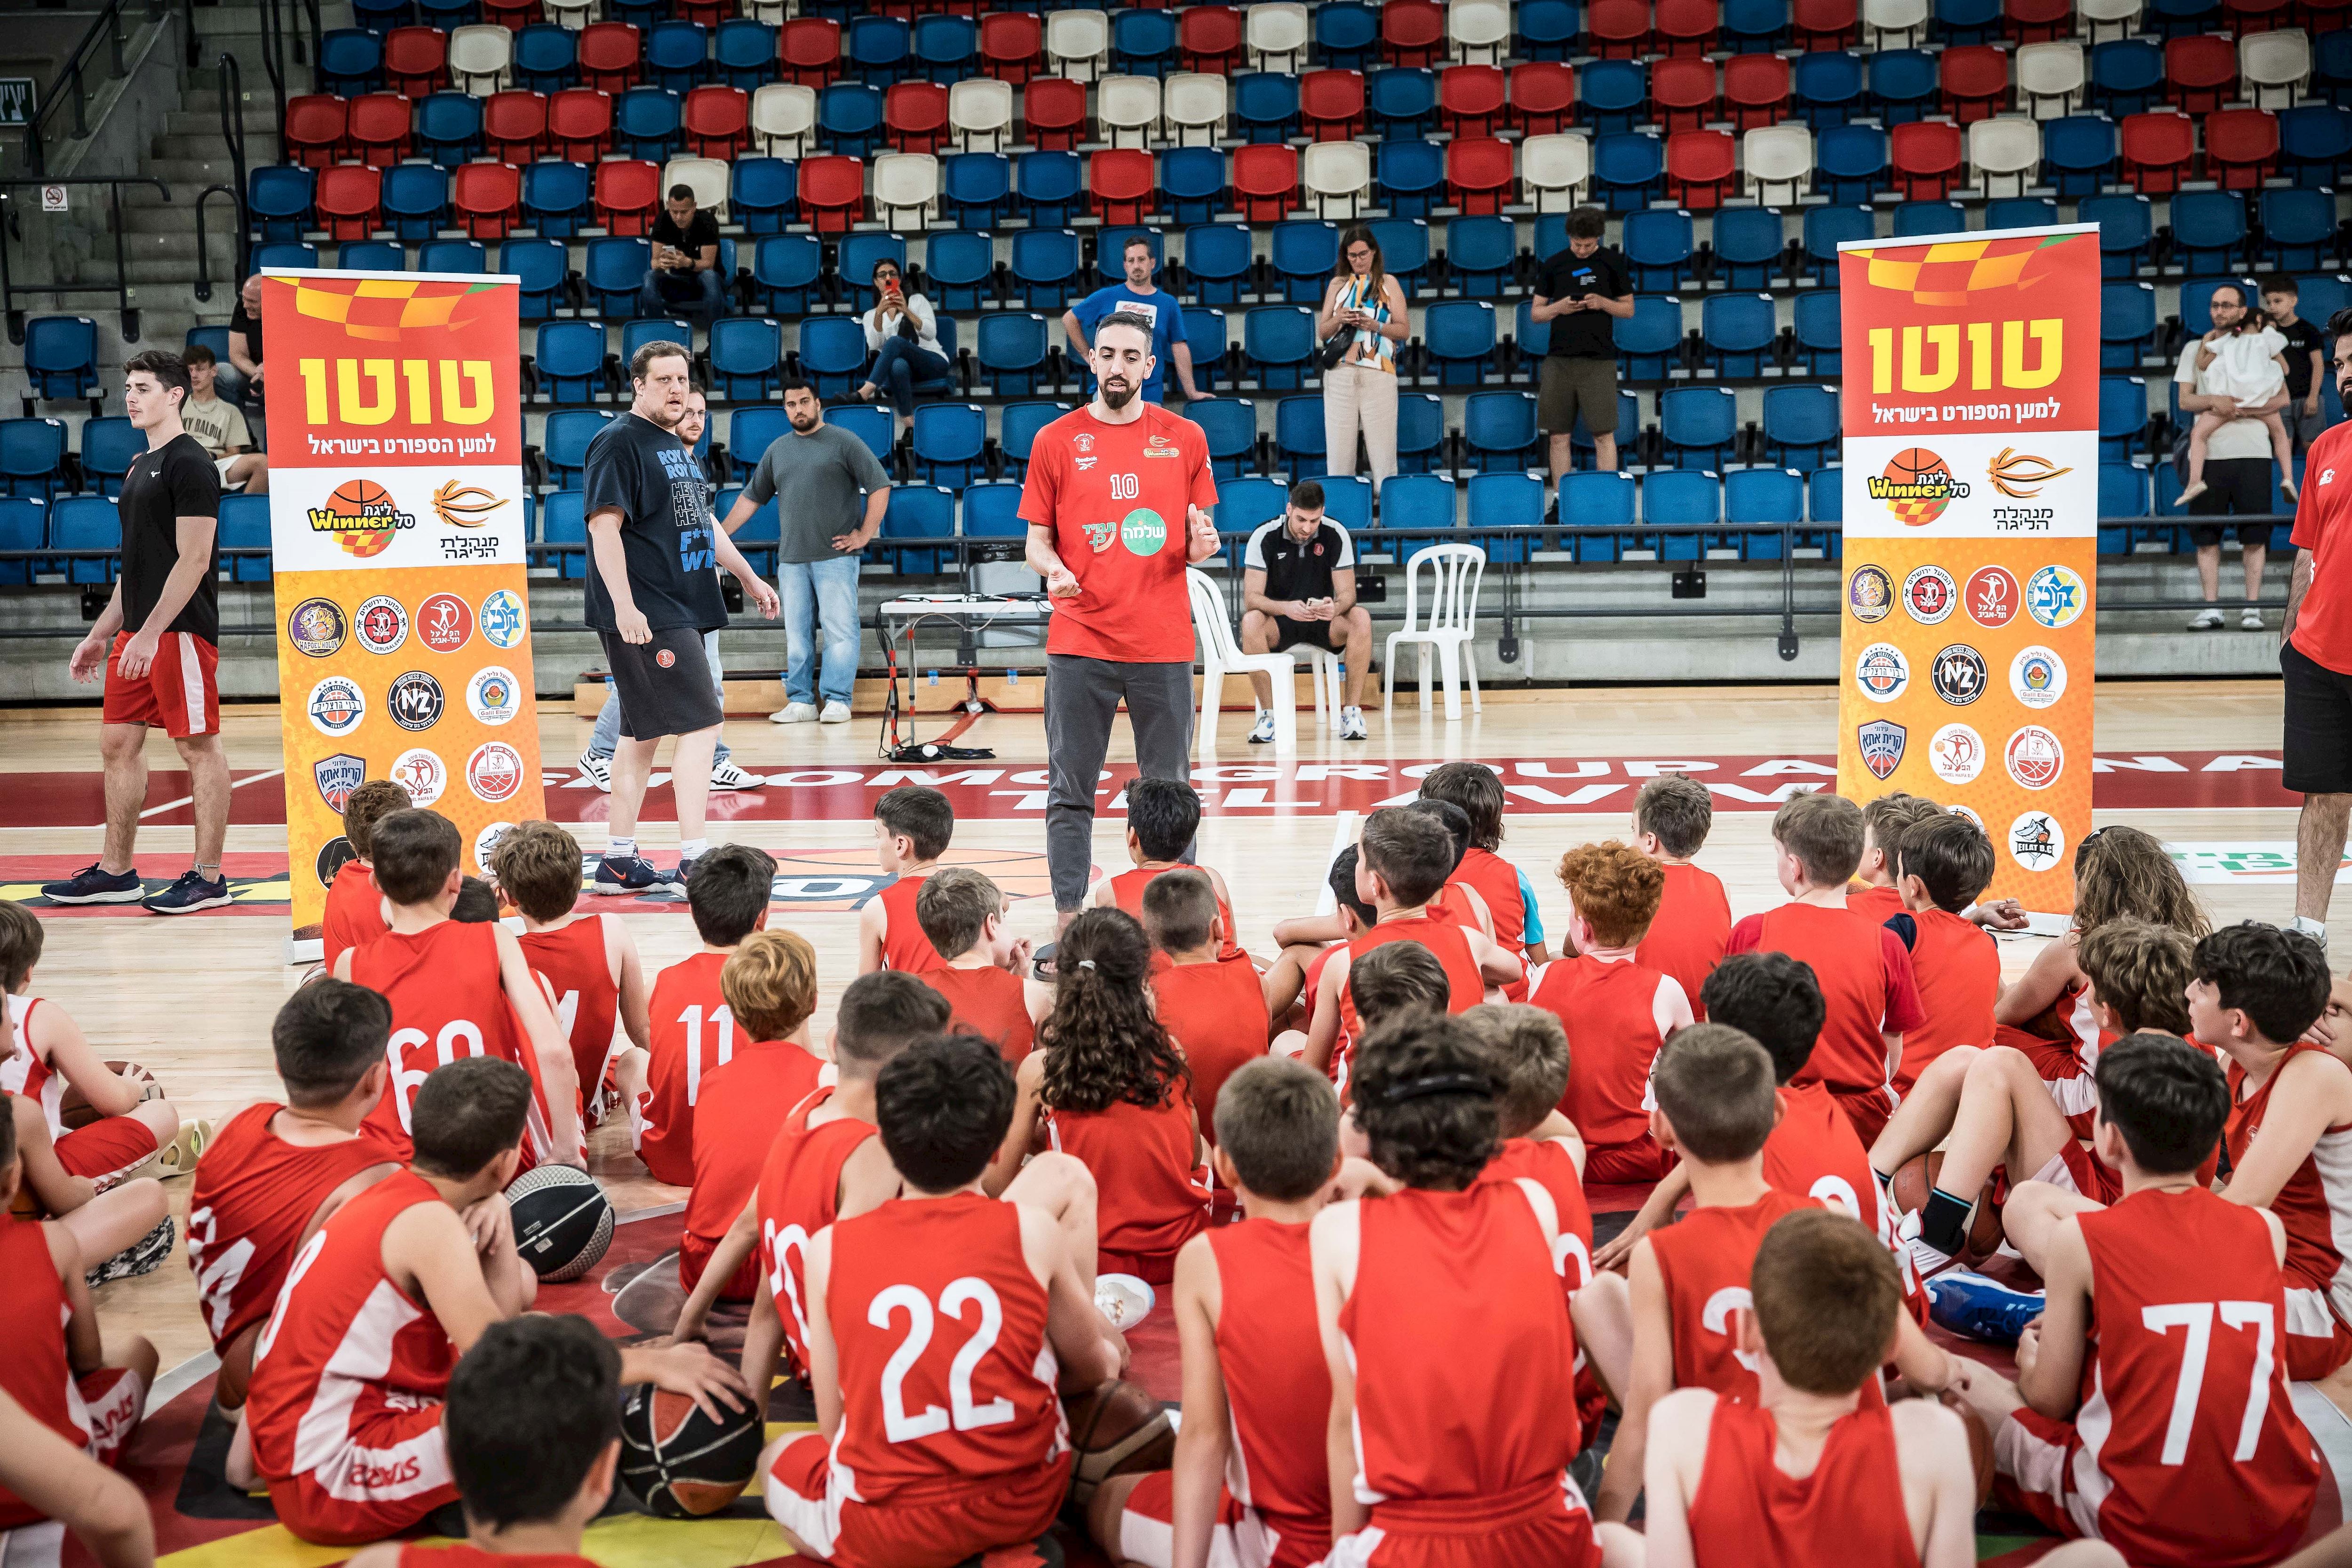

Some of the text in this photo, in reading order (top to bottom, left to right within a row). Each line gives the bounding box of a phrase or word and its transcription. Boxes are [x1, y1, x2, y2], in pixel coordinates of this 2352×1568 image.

[1868, 318, 2063, 394] טוטו
[299, 358, 494, 426] טוטו
[1872, 397, 2061, 424] למען הספורט בישראל
[308, 433, 496, 457] למען הספורט בישראל
[657, 449, 683, 465] ROY
[665, 463, 689, 479] ROY
[1917, 471, 1947, 486] ליגת
[672, 482, 694, 497] HE'S
[1110, 473, 1139, 500] 10
[1869, 478, 1969, 498] Winner סל
[364, 502, 391, 517] ליגת
[673, 495, 699, 512] HE'S
[308, 509, 414, 530] Winner סל
[675, 509, 704, 526] HE'S
[1993, 505, 2054, 519] מנהלת
[1082, 522, 1116, 534] תמיד
[1996, 517, 2049, 530] הליגה
[1123, 525, 1164, 540] שלמה
[440, 537, 499, 549] מנהלת
[445, 546, 496, 559] הליגה
[1908, 568, 1952, 585] הפועל ירושלים
[360, 598, 403, 616] הפועל ירושלים
[1906, 600, 1920, 619] HAPOEL
[1921, 610, 1948, 621] JERUSALEM
[1977, 610, 2007, 619] תל-אביב
[300, 640, 338, 650] HAPOEL HOLON
[359, 632, 373, 649] HAPOEL
[374, 638, 401, 651] JERUSALEM
[430, 636, 460, 645] תל-אביב
[2019, 654, 2030, 666] עליון
[2044, 652, 2057, 668] הפועל
[476, 675, 486, 686] עליון
[500, 672, 512, 685] הפועל
[1890, 668, 1900, 677] בני
[396, 677, 407, 687] IRONI
[420, 675, 433, 685] ZIONA
[318, 702, 342, 712] הרצליה
[1863, 733, 1902, 753] קרית אתא
[319, 768, 361, 788] קרית אתא
[2018, 843, 2038, 852] EILAT
[676, 1004, 734, 1107] 11
[868, 1276, 1016, 1443] 22
[2141, 1300, 2275, 1466] 77
